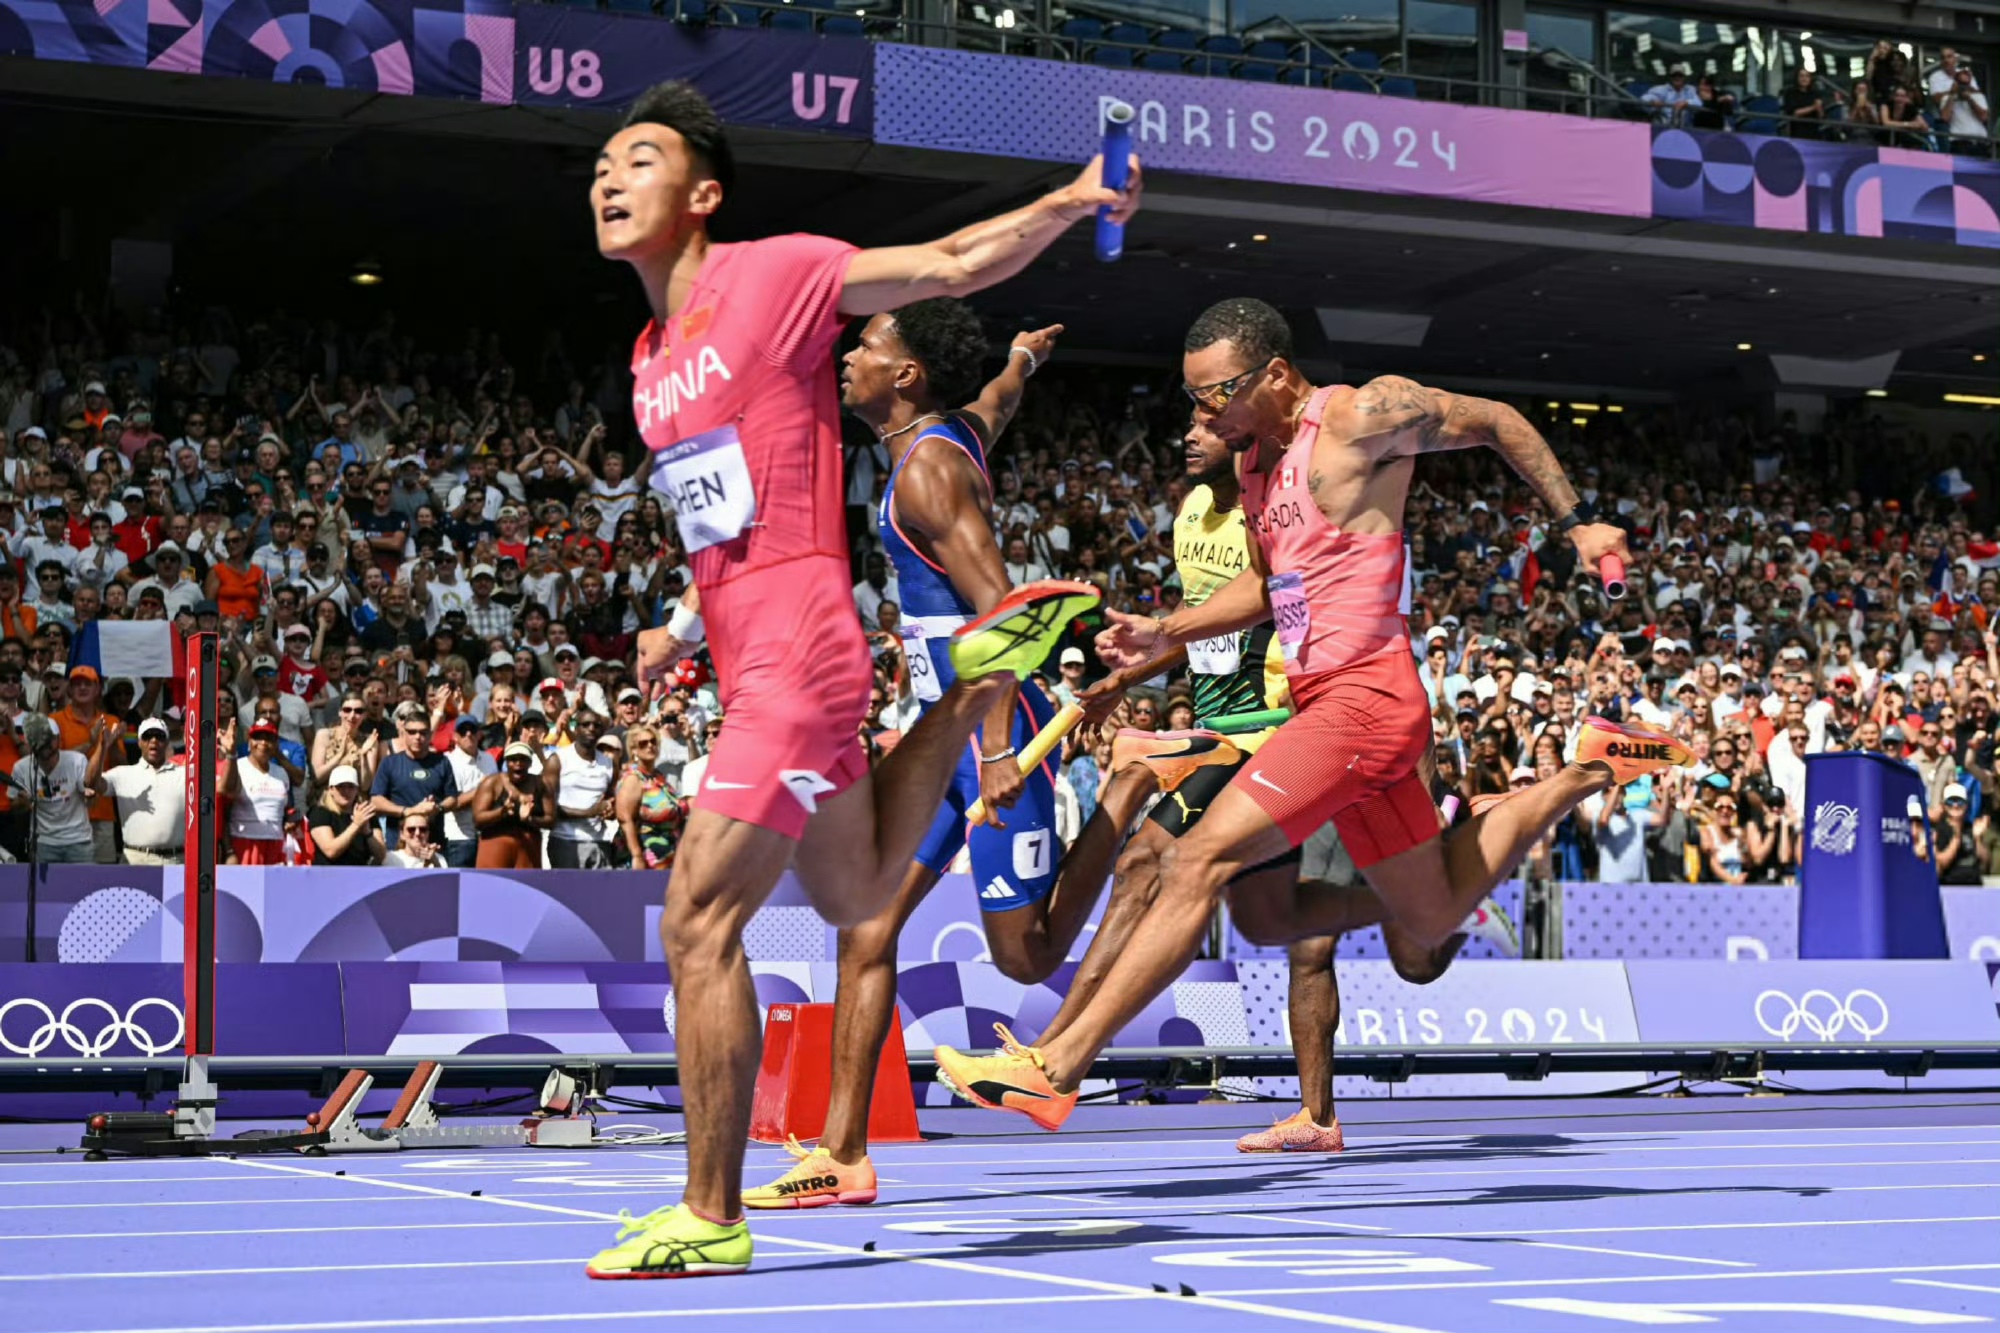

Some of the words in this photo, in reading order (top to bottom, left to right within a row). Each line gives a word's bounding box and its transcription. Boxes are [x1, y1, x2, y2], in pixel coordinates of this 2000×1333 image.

[528, 47, 603, 98] U8
[791, 72, 859, 123] U7
[1304, 116, 1457, 171] 2024
[672, 471, 726, 516] HEN
[1250, 501, 1305, 533] NADA
[1176, 541, 1243, 571] JAMAICA
[1606, 742, 1672, 760] NITRO
[188, 709, 196, 831] OMEGA
[1028, 839, 1042, 868] 7
[1465, 1008, 1607, 1044] 2024
[774, 1175, 838, 1197] NITRO
